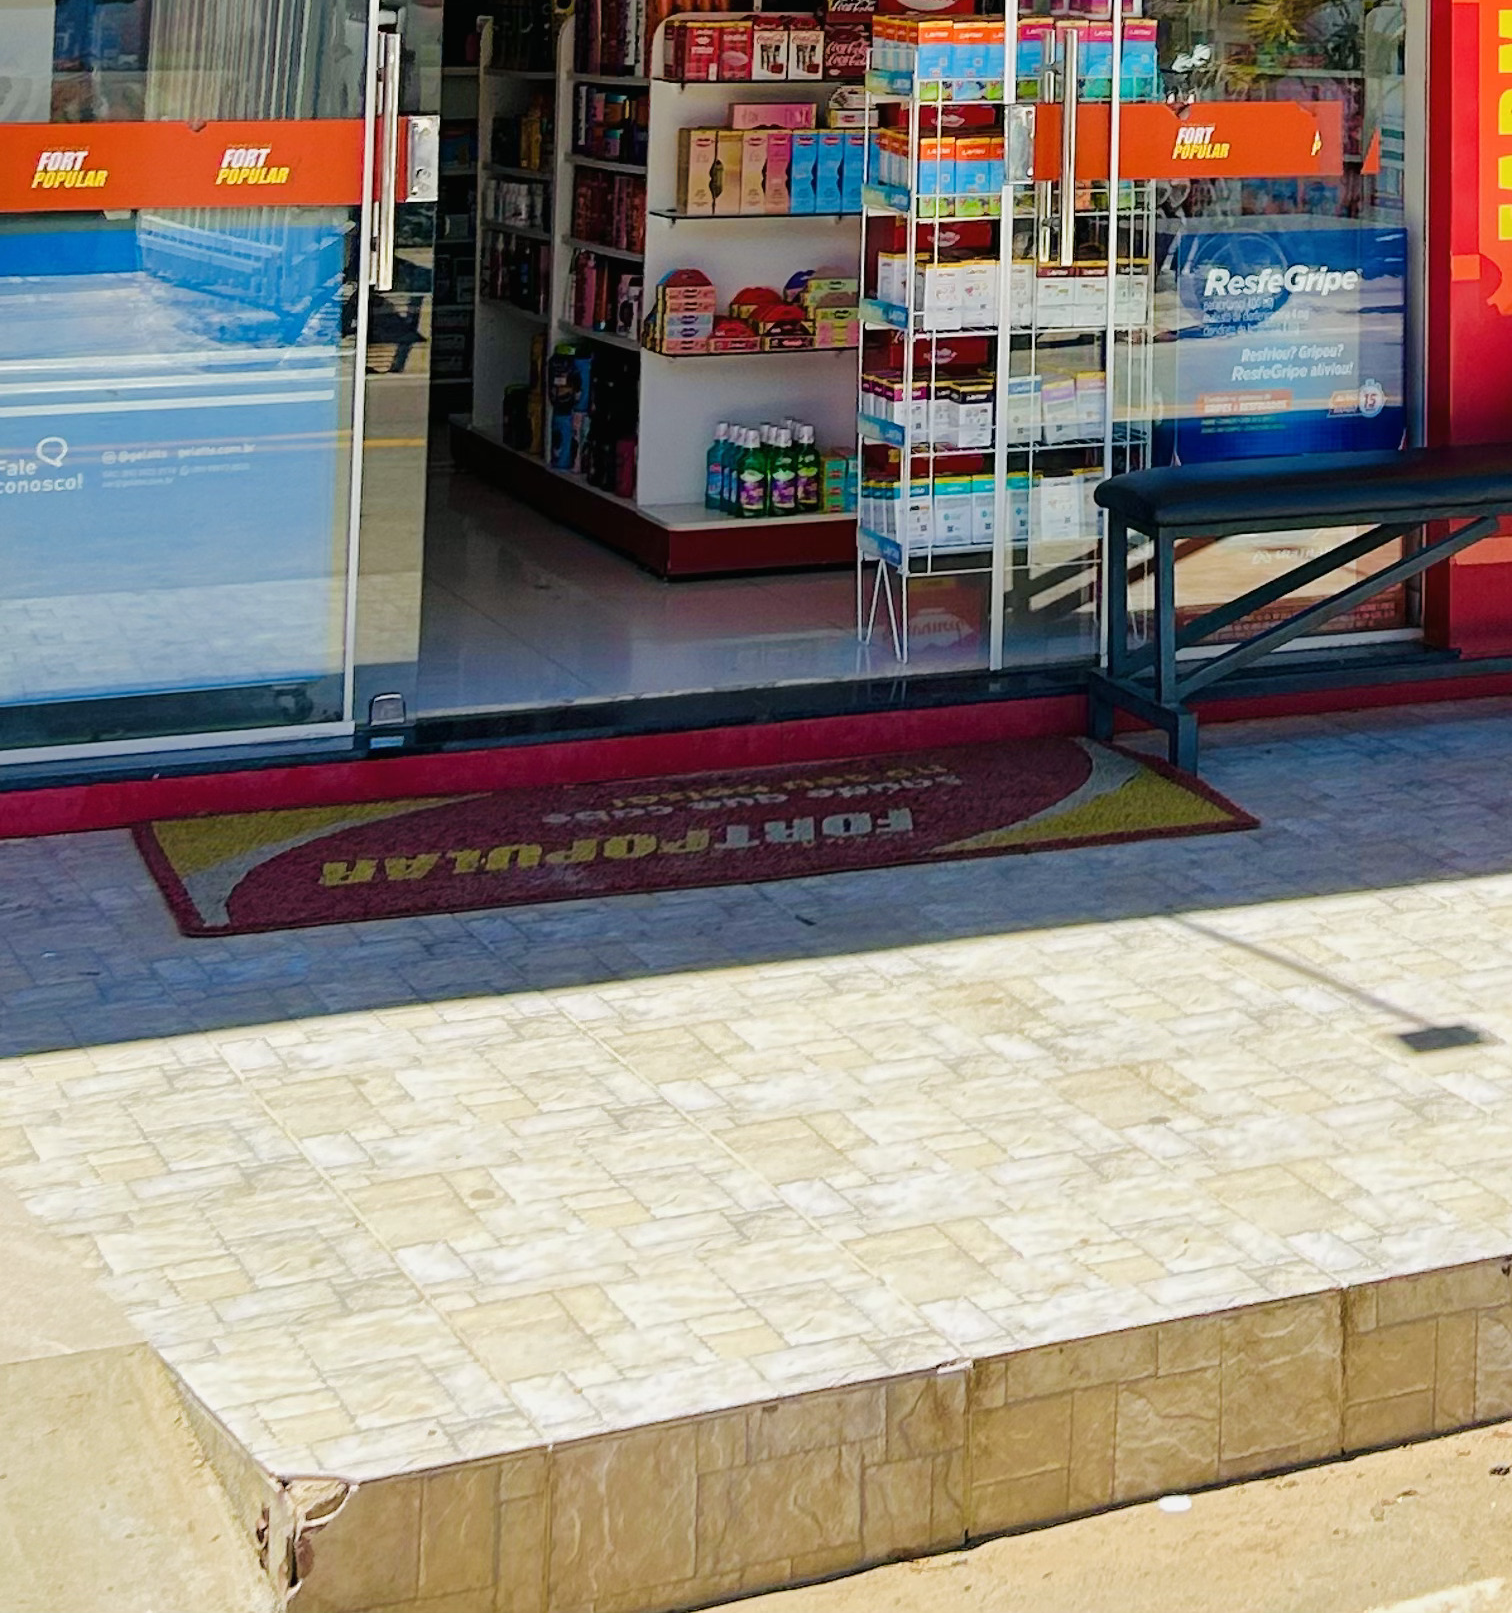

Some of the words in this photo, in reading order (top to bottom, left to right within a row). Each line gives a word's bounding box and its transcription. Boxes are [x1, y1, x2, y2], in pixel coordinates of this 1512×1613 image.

[1176, 126, 1215, 144] FORT
[36, 150, 90, 171] FORT
[220, 147, 272, 169] FORT
[1172, 143, 1230, 160] POPULAR
[32, 169, 108, 189] POPULAR
[216, 167, 289, 186] POPULAR
[1203, 264, 1360, 296] ResfeGripe
[1241, 346, 1298, 363] Resfriou?
[1298, 343, 1345, 361] Gripou?
[1231, 363, 1308, 382] ResfeGripe
[1310, 361, 1354, 377] aliviou!
[1363, 392, 1377, 408] 15
[316, 806, 914, 888] FORTPOPULAR
